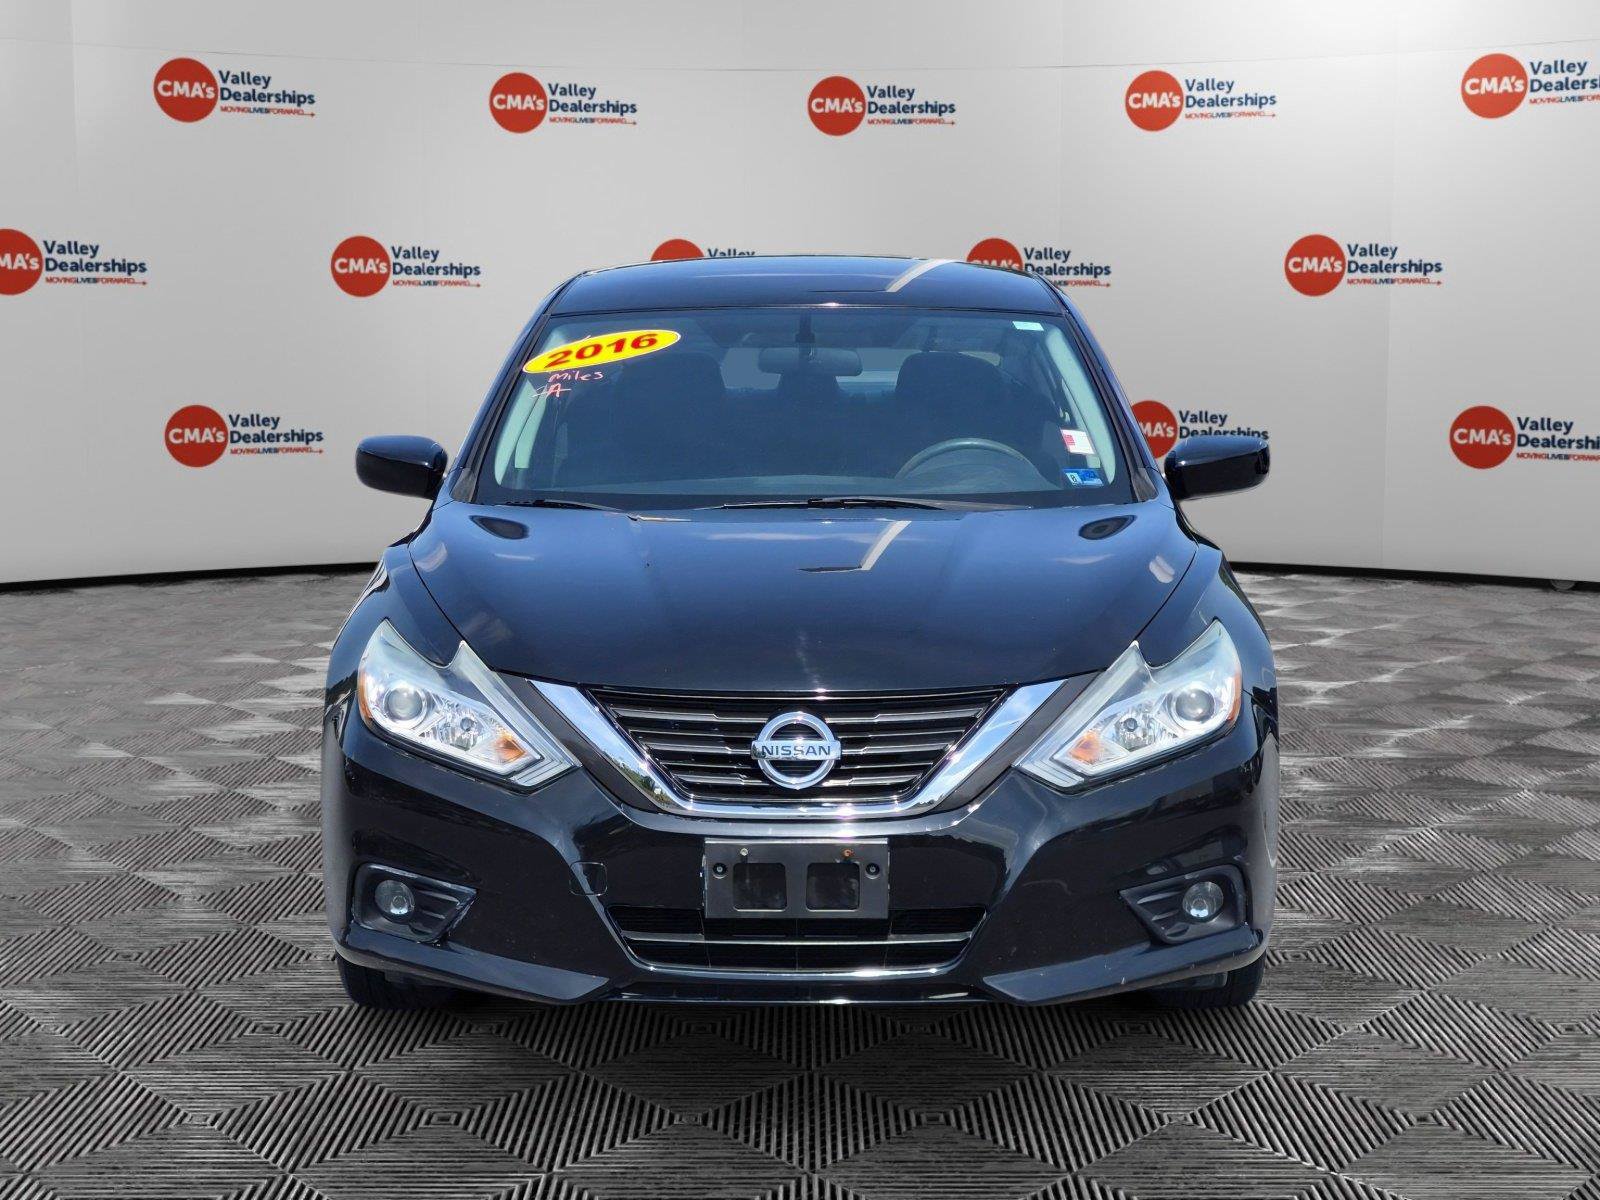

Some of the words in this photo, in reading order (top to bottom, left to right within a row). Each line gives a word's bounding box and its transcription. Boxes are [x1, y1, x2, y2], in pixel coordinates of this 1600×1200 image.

[1530, 60, 1588, 76] Valley
[219, 70, 271, 88] Valley
[1185, 78, 1234, 94] Valley
[1464, 75, 1525, 96] CMA's
[157, 80, 216, 99] CMA's
[220, 87, 315, 107] Dealerships
[548, 83, 596, 99] Valley
[867, 85, 915, 101] Valley
[492, 93, 545, 111] CMA's
[549, 100, 637, 116] Dealerships
[811, 97, 863, 114] CMA's
[868, 101, 955, 116] Dealerships
[1128, 91, 1181, 110] CMA's
[1185, 93, 1276, 110] Dealerships
[43, 240, 100, 258] Valley
[392, 246, 440, 263] Valley
[1024, 247, 1071, 263] Valley
[1347, 243, 1398, 260] Valley
[45, 257, 147, 276] Dealerships
[334, 257, 388, 275] CMA's
[392, 262, 481, 279] Dealerships
[1025, 262, 1111, 279] Dealerships
[1288, 256, 1343, 273] CMA's
[1347, 258, 1443, 276] Dealerships
[544, 333, 658, 369] 2016
[229, 414, 281, 430] Valley
[1179, 410, 1228, 427] Valley
[1516, 416, 1574, 436] Valley
[168, 428, 226, 444] CMA's
[230, 429, 324, 445] Dealerships
[1139, 422, 1174, 438] MA's
[1453, 428, 1512, 446] CMA's
[762, 745, 831, 756] NISSAN
